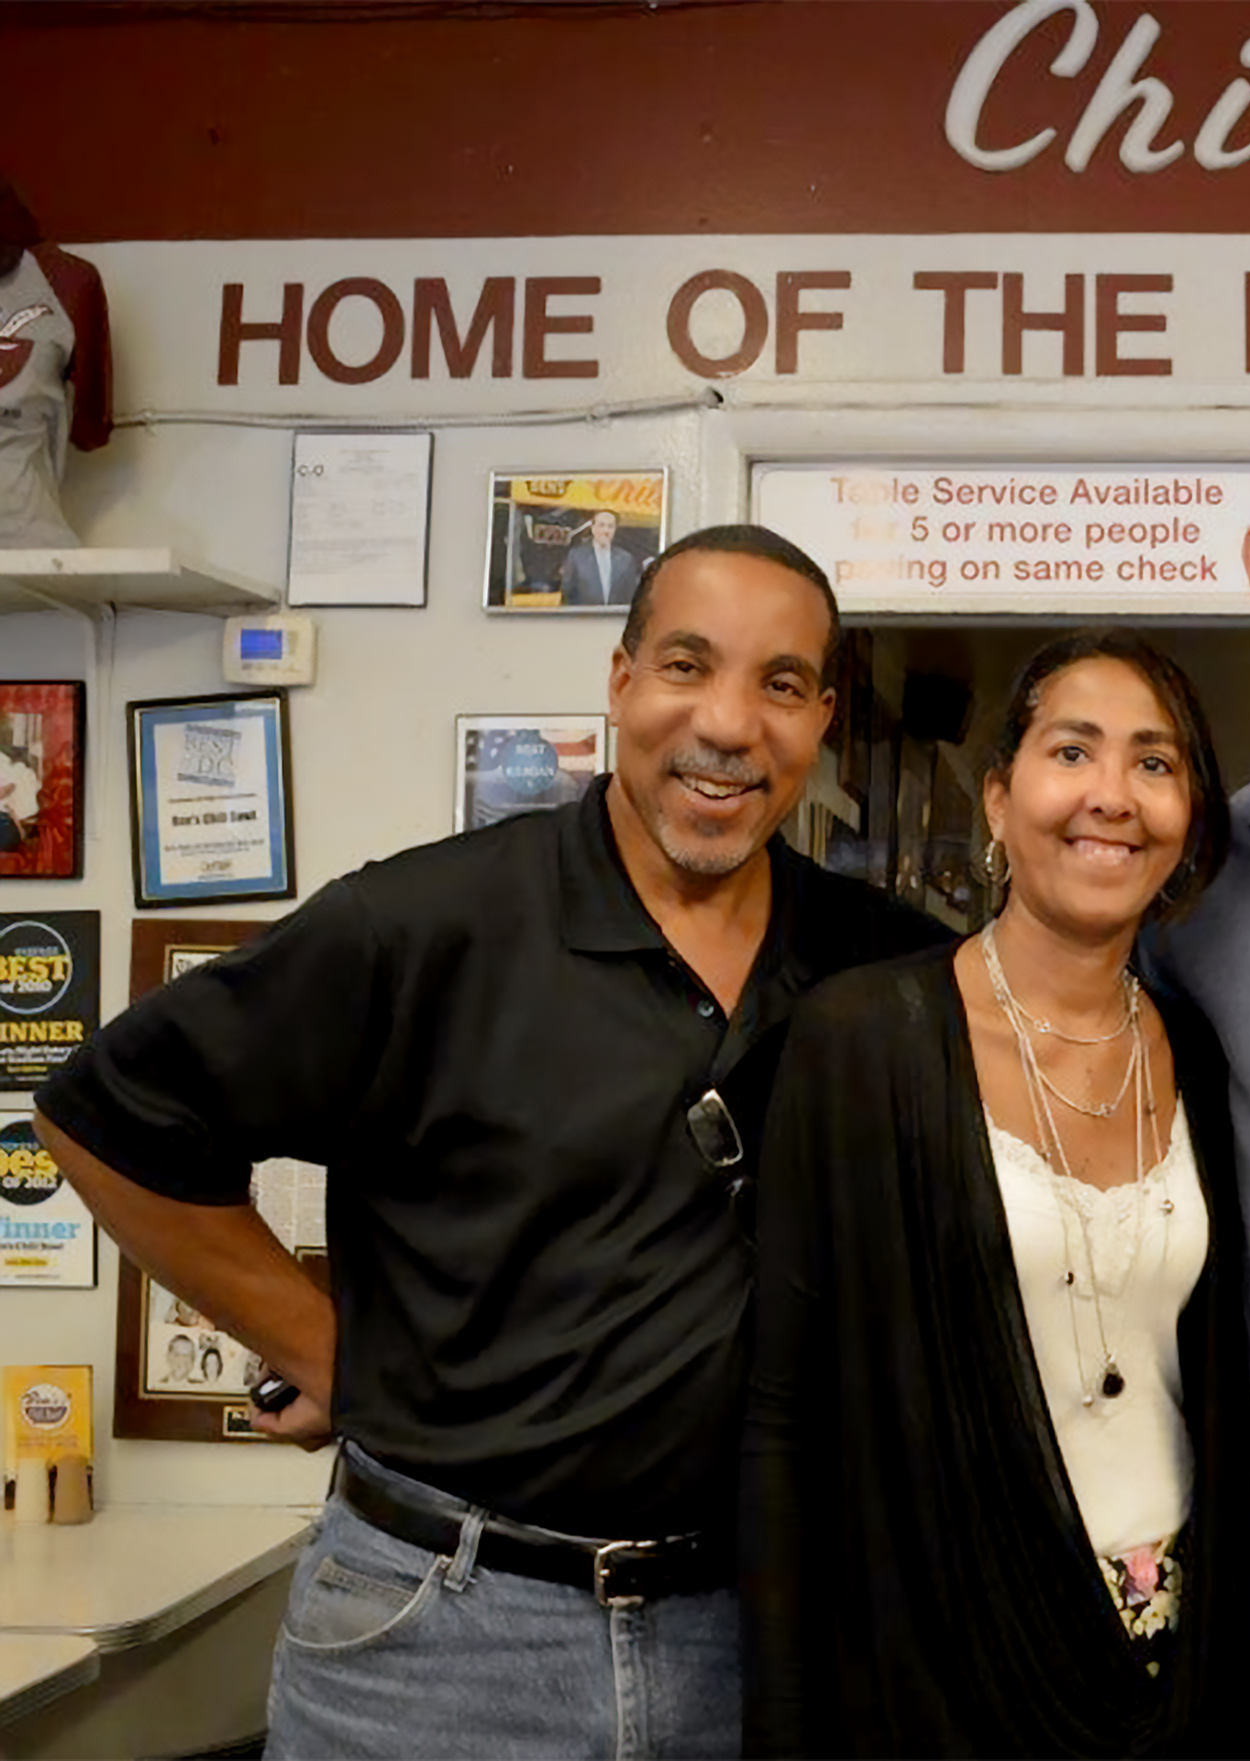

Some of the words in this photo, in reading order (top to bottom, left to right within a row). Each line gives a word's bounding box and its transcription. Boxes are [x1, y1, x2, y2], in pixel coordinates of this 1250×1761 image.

[216, 276, 602, 387] HOME
[666, 269, 851, 380] OF
[913, 271, 1174, 377] THE
[931, 476, 1059, 507] Service
[1068, 477, 1225, 507] Available
[910, 515, 930, 543] 5
[941, 521, 977, 543] or
[986, 521, 1073, 544] more
[1083, 516, 1202, 550] people
[834, 555, 948, 589] ping
[959, 560, 1002, 582] on
[1011, 560, 1106, 582] same
[1115, 554, 1219, 583] check
[0, 1020, 84, 1042] INNER
[0, 1217, 81, 1240] inner
